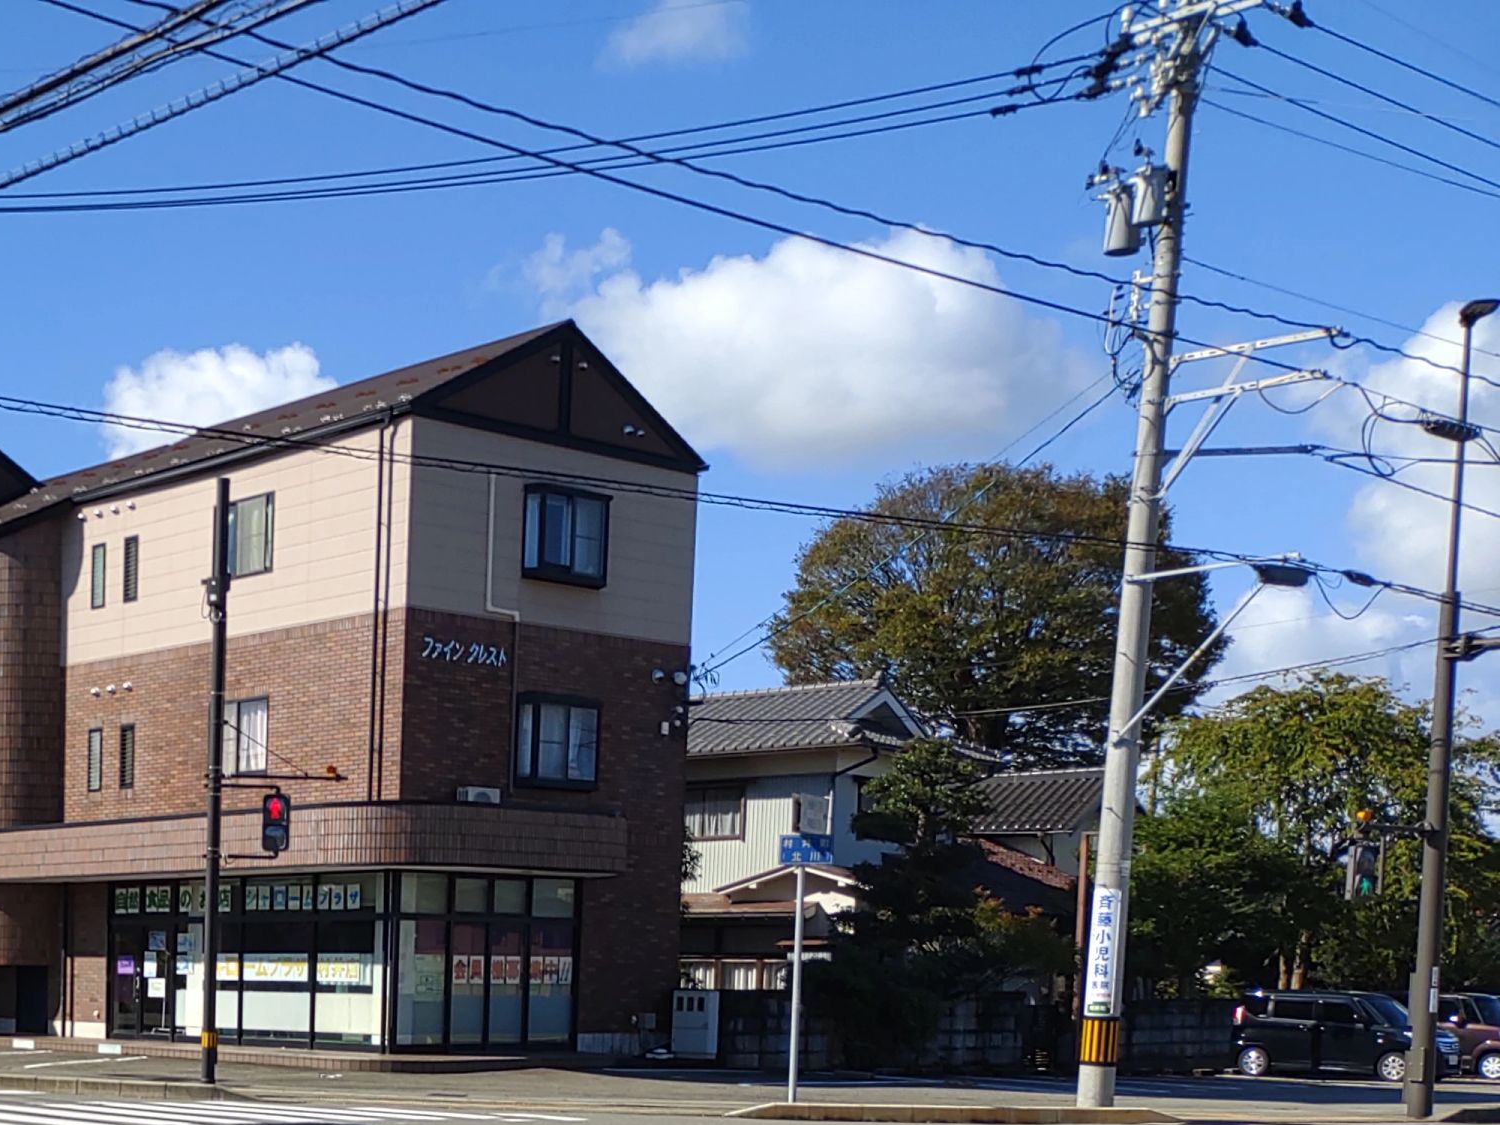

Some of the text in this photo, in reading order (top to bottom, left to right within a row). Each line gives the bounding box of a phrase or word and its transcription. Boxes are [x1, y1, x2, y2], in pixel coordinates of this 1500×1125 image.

[422, 637, 507, 667] ファイン クレスト
